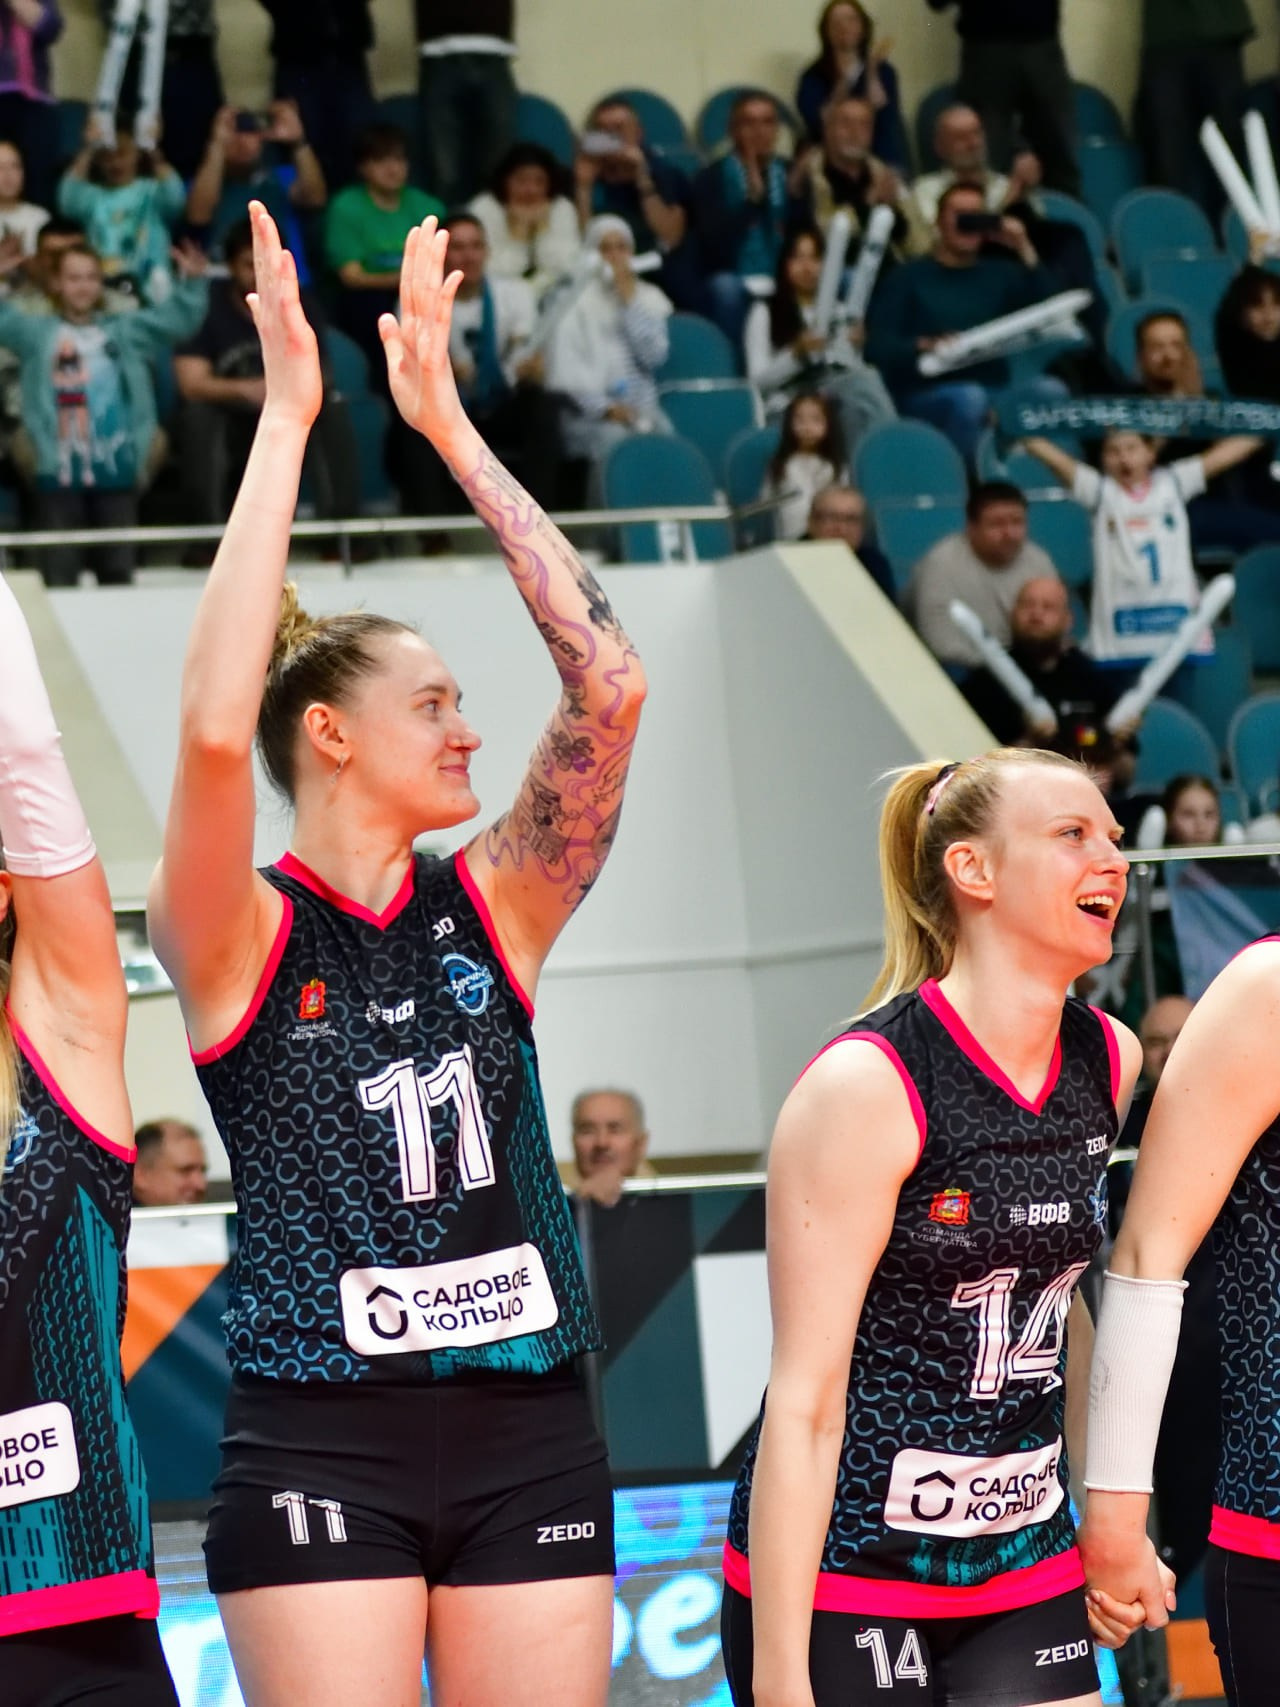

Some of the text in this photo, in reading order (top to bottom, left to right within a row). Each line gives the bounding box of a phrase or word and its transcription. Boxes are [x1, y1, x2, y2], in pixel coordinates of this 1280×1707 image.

[1140, 541, 1160, 584] 1
[358, 1043, 496, 1202] 11
[922, 1226, 971, 1239] КОМАНДА
[1027, 1202, 1070, 1226] ВФВ
[910, 1231, 979, 1249] ГУБЕРНАТОРА
[413, 1266, 532, 1309] САДОВОЕ
[421, 1296, 524, 1332] КОЛЬЦО
[951, 1261, 1090, 1400] 14
[272, 1490, 347, 1545] 11
[537, 1521, 595, 1544] ZEDO
[855, 1628, 928, 1689] 14
[1035, 1639, 1089, 1667] ZEDO
